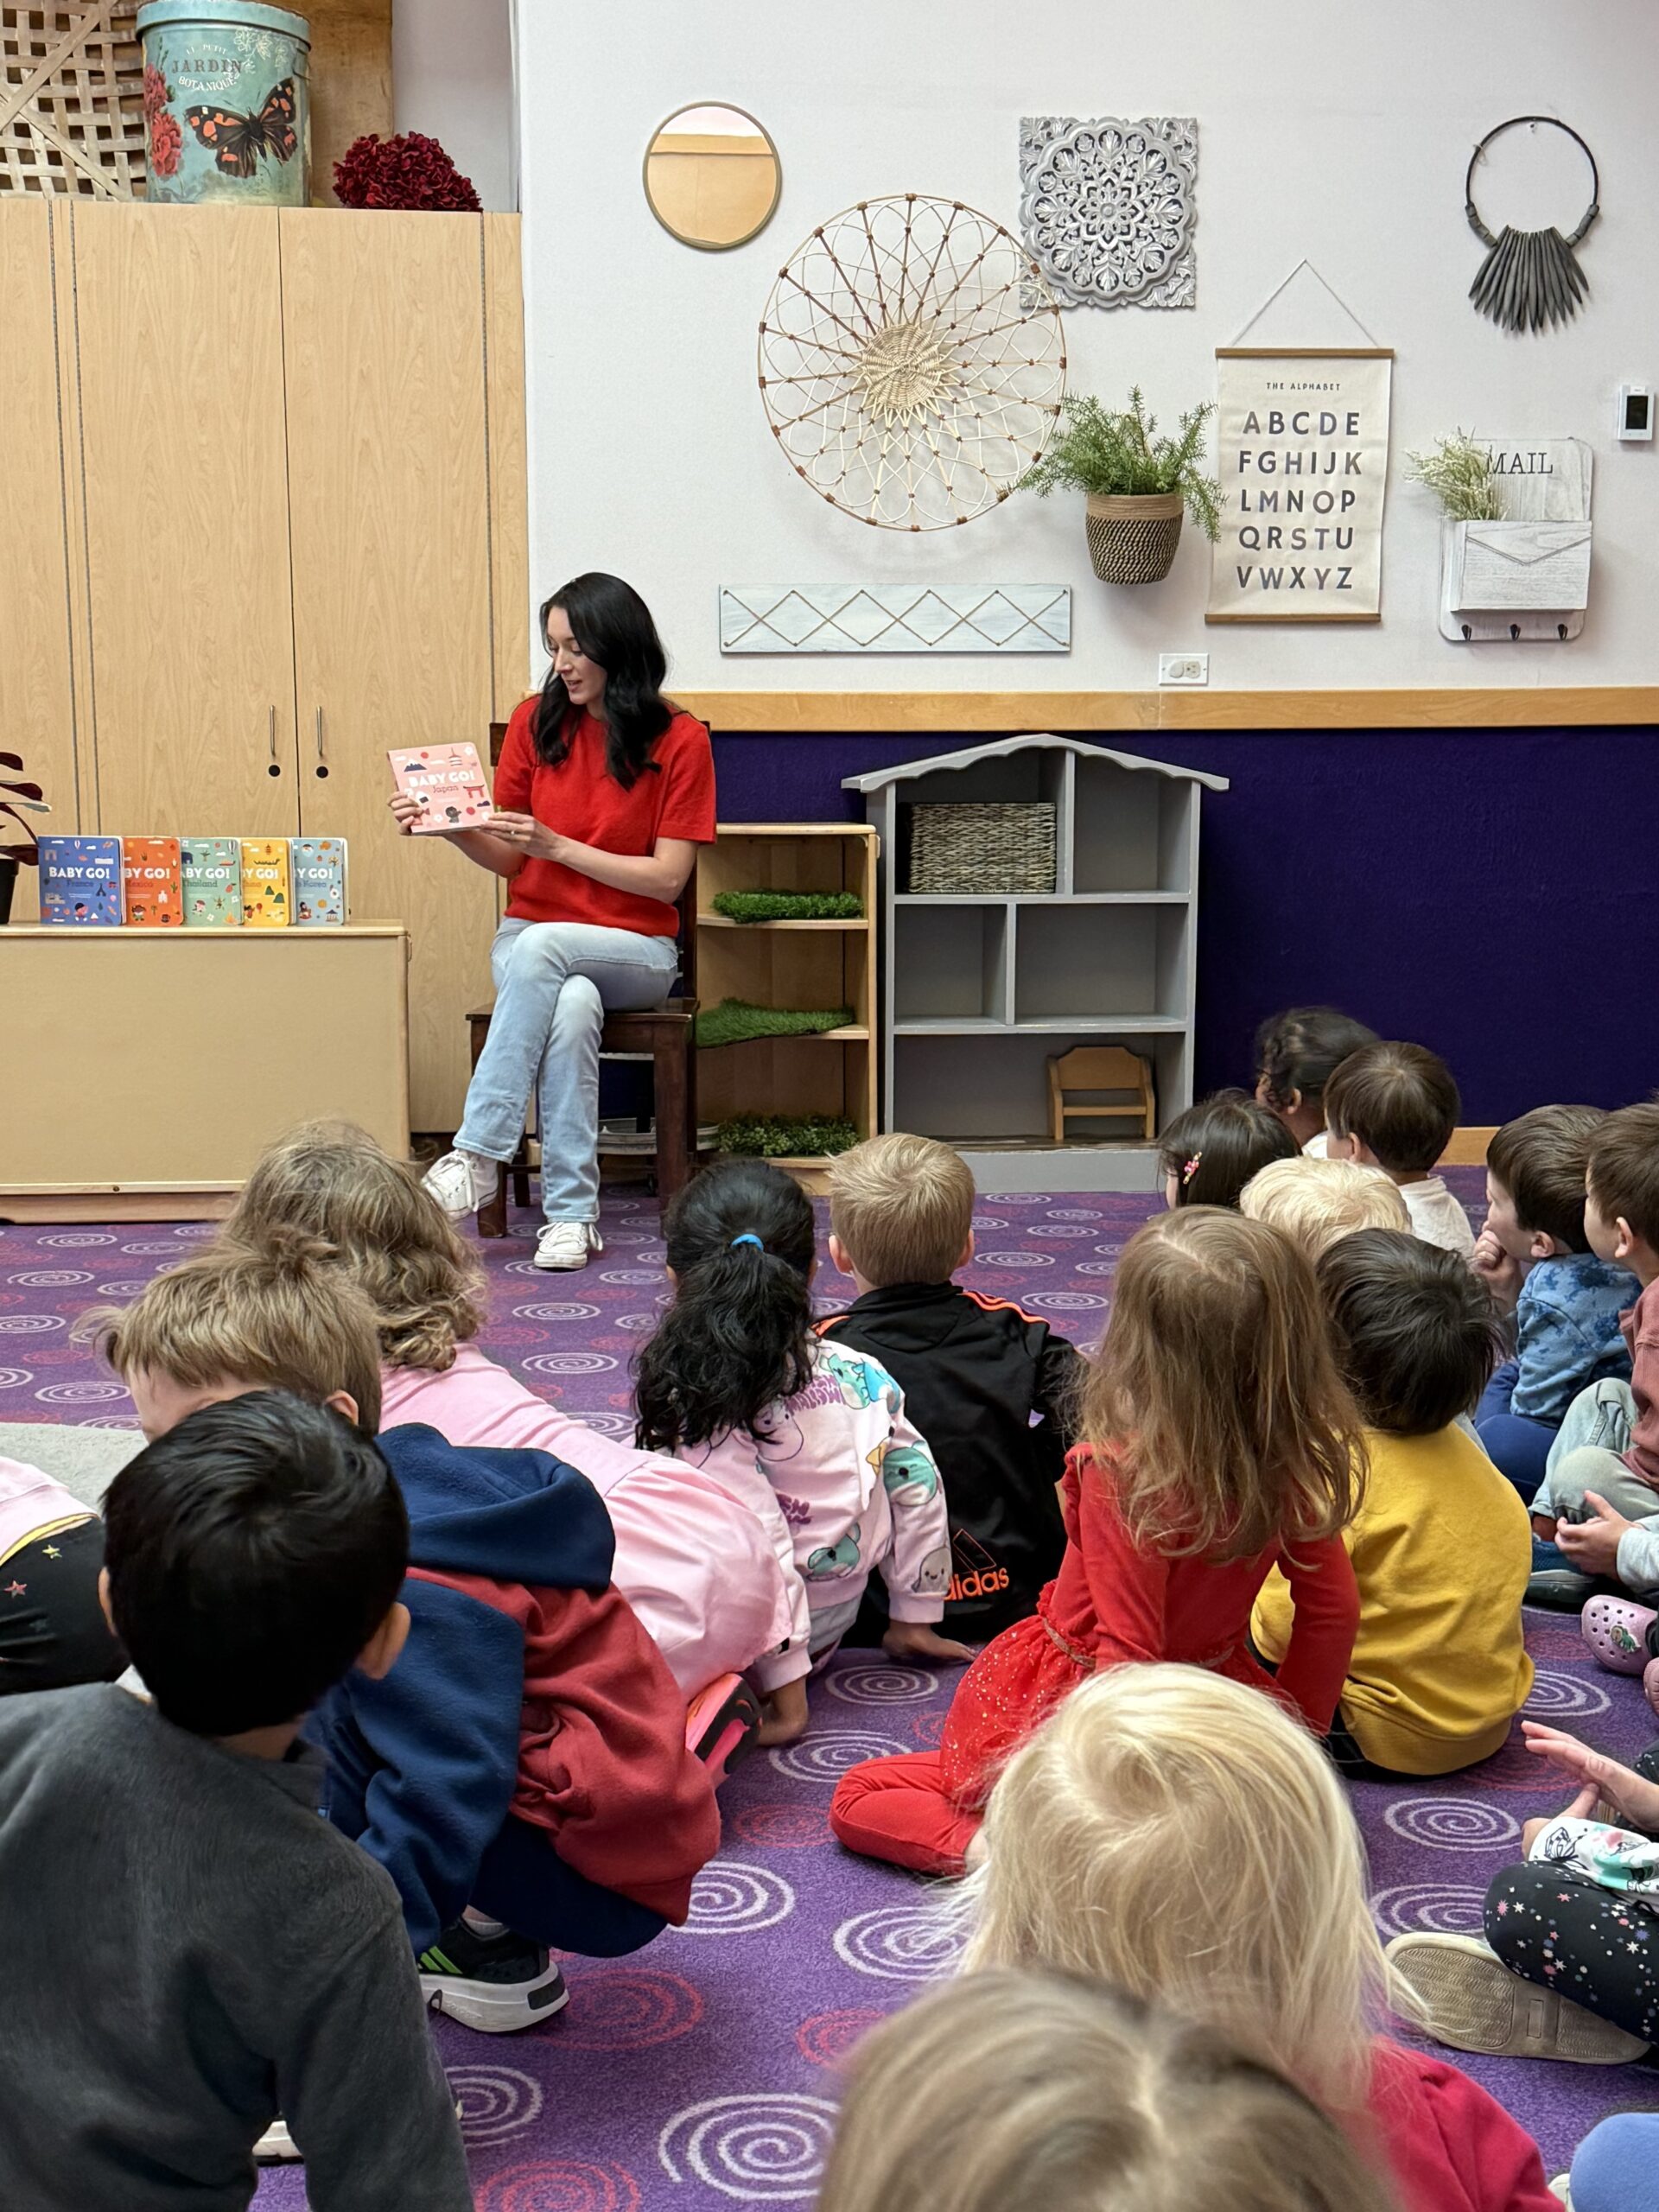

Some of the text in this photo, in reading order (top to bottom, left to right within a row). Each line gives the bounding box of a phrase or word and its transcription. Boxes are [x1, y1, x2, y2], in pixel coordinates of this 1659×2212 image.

[172, 59, 242, 74] JARDIN
[1266, 382, 1341, 391] THE ALPHABET
[1242, 410, 1361, 436] ABCDE
[1238, 449, 1363, 475] FGHIJK
[1487, 451, 1554, 474] MAIL
[1241, 489, 1357, 514] LMNOP
[1238, 525, 1354, 551] QRSTU
[1236, 565, 1353, 591] VWXYZ
[408, 770, 475, 788] BABY GO!
[433, 785, 459, 793] Japan
[48, 867, 110, 880] BABY GO!
[124, 868, 170, 880] BY GO!
[181, 868, 203, 879] BY
[205, 868, 230, 880] GO!
[256, 868, 278, 880] GO!
[308, 868, 333, 880] GO!
